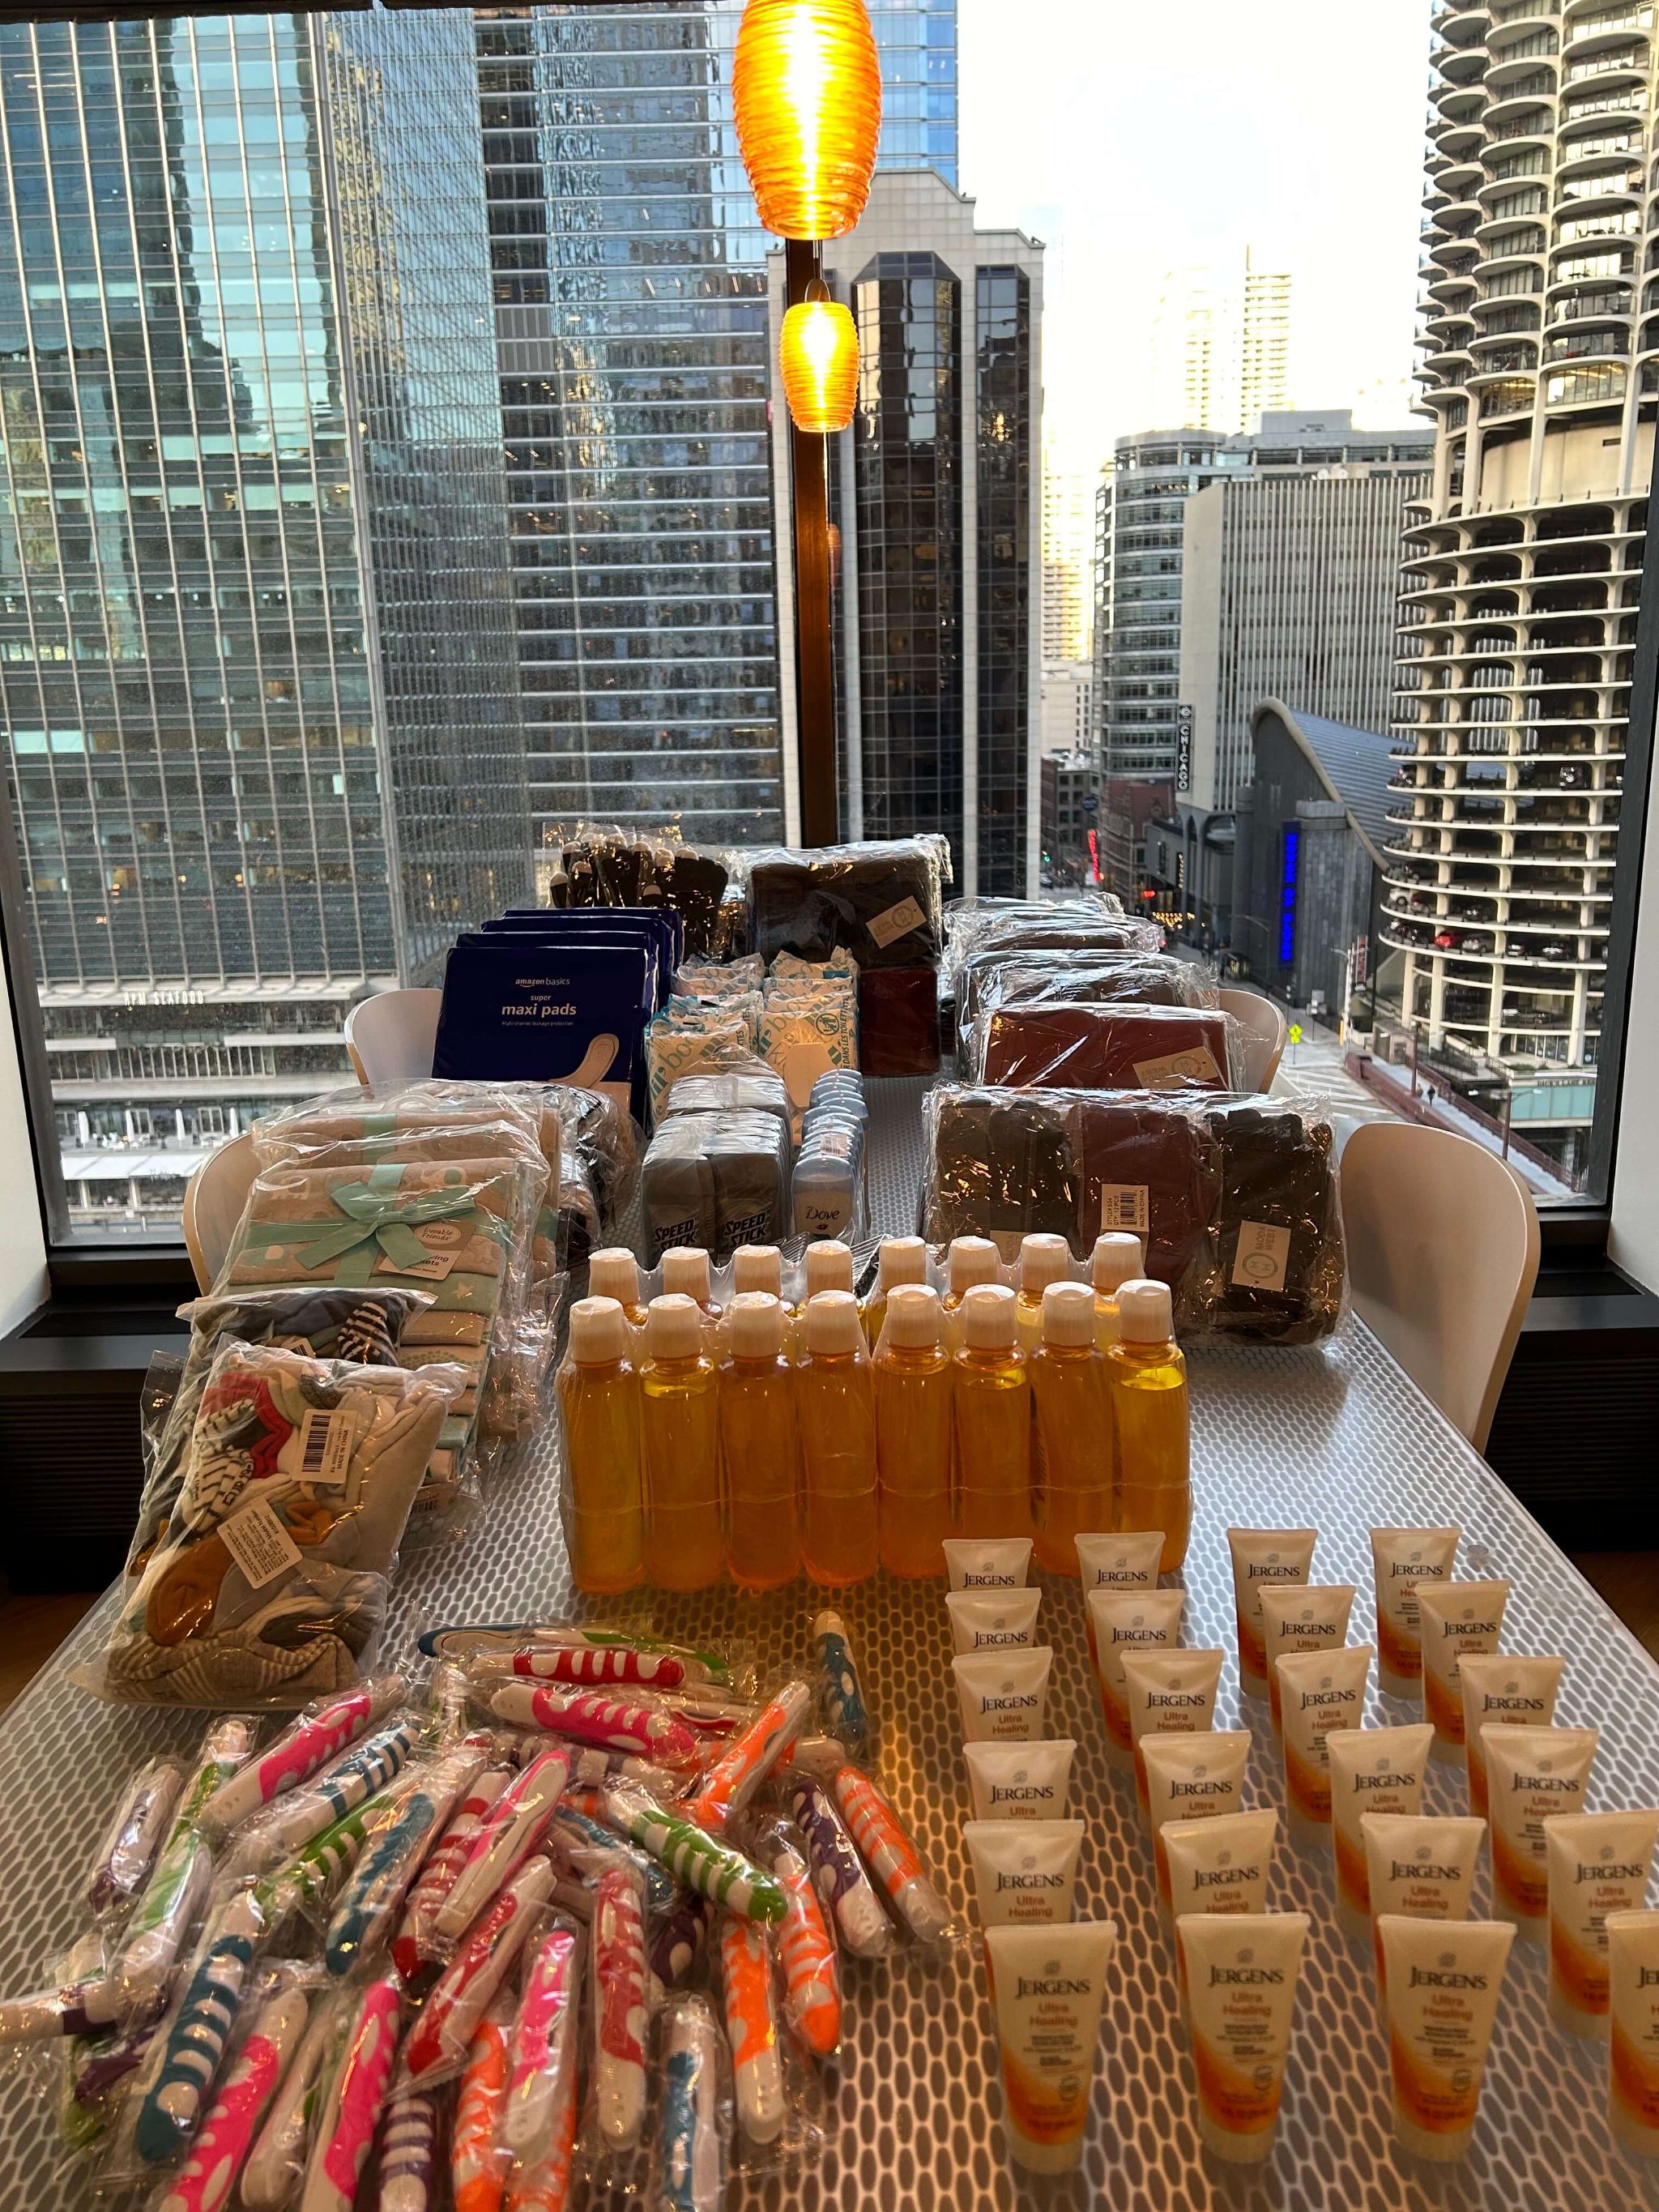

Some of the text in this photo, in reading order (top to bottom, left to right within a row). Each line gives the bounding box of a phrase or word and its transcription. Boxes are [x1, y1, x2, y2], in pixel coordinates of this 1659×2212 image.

[1179, 725, 1189, 790] CHICAGO
[154, 990, 203, 1005] SEAFOOD
[502, 1003, 577, 1018] maxi pads
[805, 1206, 839, 1220] Dove
[655, 1219, 696, 1242] SPEED
[724, 1211, 767, 1236] SPEED
[421, 1232, 450, 1241] Friends
[660, 1230, 697, 1251] STICK
[731, 1223, 769, 1247] STICK
[1255, 1226, 1267, 1250] MODA
[1265, 1228, 1276, 1250] WEST
[341, 1429, 349, 1446] CHINA
[1096, 1569, 1148, 1584] JERGENS
[1247, 1564, 1300, 1579] JERGENS
[1389, 1562, 1444, 1577] JERGENS
[963, 1573, 1015, 1587] JERGENS
[1111, 1627, 1166, 1643] JERGENS
[1278, 1621, 1336, 1637] JERGENS
[1443, 1621, 1496, 1638] JERGENS
[974, 1631, 1028, 1648] JERGENS
[1297, 1639, 1320, 1649] Ultra
[1460, 1639, 1482, 1648] Ultra
[980, 1695, 1038, 1714] JERGENS
[1145, 1692, 1205, 1709] JERGENS
[1300, 1689, 1356, 1710] JERGENS
[1482, 1693, 1544, 1711] JERGENS
[999, 1715, 1022, 1724] Ultra
[1164, 1712, 1188, 1722] Ultra
[1318, 1710, 1341, 1719] Ultra
[1501, 1715, 1527, 1724] Ultra
[992, 1724, 1029, 1735] Healing
[1157, 1722, 1195, 1732] Healing
[1311, 1719, 1348, 1731] Healing
[1353, 1773, 1415, 1792] JERGENS
[1512, 1772, 1579, 1792] JERGENS
[990, 1785, 1054, 1804] JERGENS
[1169, 1781, 1233, 1800] JERGENS
[1189, 1801, 1215, 1811] Ultra
[1372, 1794, 1400, 1804] Ultra
[1532, 1796, 1560, 1808] Ultra
[1009, 1806, 1036, 1816] Ultra
[1388, 1860, 1461, 1881] JERGENS
[1573, 1864, 1644, 1884] JERGENS
[996, 1873, 1064, 1893] JERGENS
[1193, 1867, 1259, 1890] JERGENS
[1213, 1890, 1241, 1902] Ultra
[1410, 1886, 1441, 1898] Ultra
[1597, 1886, 1625, 1897] Ultra
[1016, 1894, 1045, 1906] Ultra
[1402, 1897, 1448, 1911] Healing
[1589, 1897, 1632, 1910] Healing
[1009, 1906, 1053, 1919] Healing
[1207, 1964, 1285, 1988] JERGENS
[1408, 1966, 1488, 1989] JERGENS
[1014, 1976, 1091, 1999] JERGENS
[1231, 1992, 1263, 2003] Ultra
[1431, 1994, 1465, 2007] Ultra
[1038, 2002, 1068, 2013] Ultra
[1223, 2005, 1272, 2018] Healing
[1422, 2005, 1473, 2022] Healing
[1030, 2015, 1078, 2029] Healing
